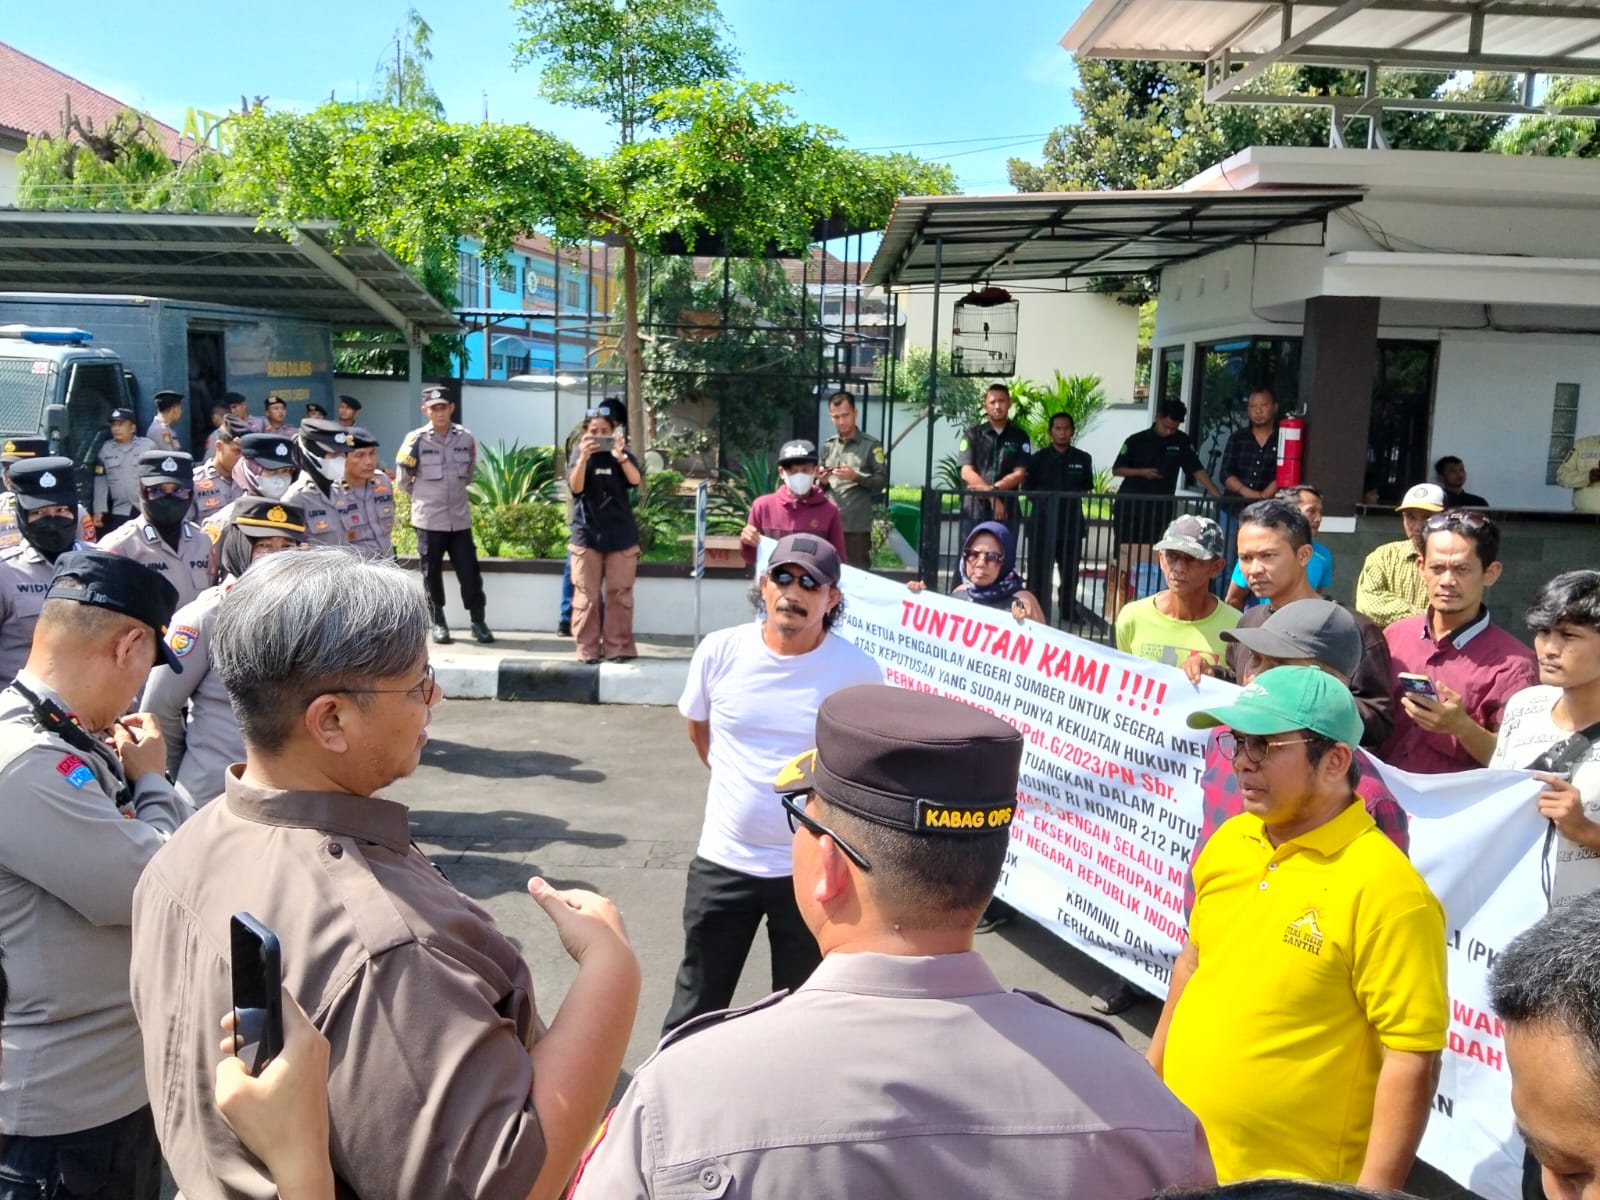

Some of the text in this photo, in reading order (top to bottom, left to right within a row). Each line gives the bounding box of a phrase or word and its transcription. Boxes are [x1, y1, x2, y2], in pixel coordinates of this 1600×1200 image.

[866, 621, 895, 643] KETUA
[898, 633, 964, 667] PENGADILAN
[966, 660, 1012, 684] NEGERI
[1014, 673, 1066, 706] SUMBER
[1069, 694, 1111, 724] UNTUK
[1113, 713, 1165, 748] SEGERA
[901, 600, 1168, 716] TUNTUTAN KAMI !!!!
[854, 636, 875, 654] ATAS
[878, 647, 936, 678] KEPUTUSAN
[938, 669, 967, 691] YANG
[970, 679, 1011, 708] SUDAH
[1014, 698, 1053, 726] PUNYA
[1057, 714, 1121, 755] KEKUATAN
[1123, 744, 1187, 779] HUKUM
[1193, 767, 1203, 785] T
[925, 807, 1012, 828] KABAG OPS
[1025, 751, 1095, 793] TUANGKAN
[1099, 783, 1155, 818] DALAM
[1141, 772, 1178, 804] Sbr.
[1056, 807, 1185, 889] DENGAN SELALU M
[1065, 790, 1080, 808] RI
[1084, 798, 1138, 835] NOMOR
[1141, 824, 1166, 852] 212
[1170, 840, 1191, 865] PK
[1011, 825, 1023, 842] DI
[1026, 834, 1074, 873] NEGARA
[1077, 863, 1142, 914] REPUBLIK
[1033, 815, 1093, 860] EKSEKUSI
[1097, 851, 1183, 914] MERUPAKAN
[1065, 889, 1120, 938] KRIMINIL
[1123, 927, 1155, 957] DAN
[1132, 953, 1173, 987] PERI
[1449, 997, 1505, 1040] WAN
[1432, 1094, 1453, 1118] N
